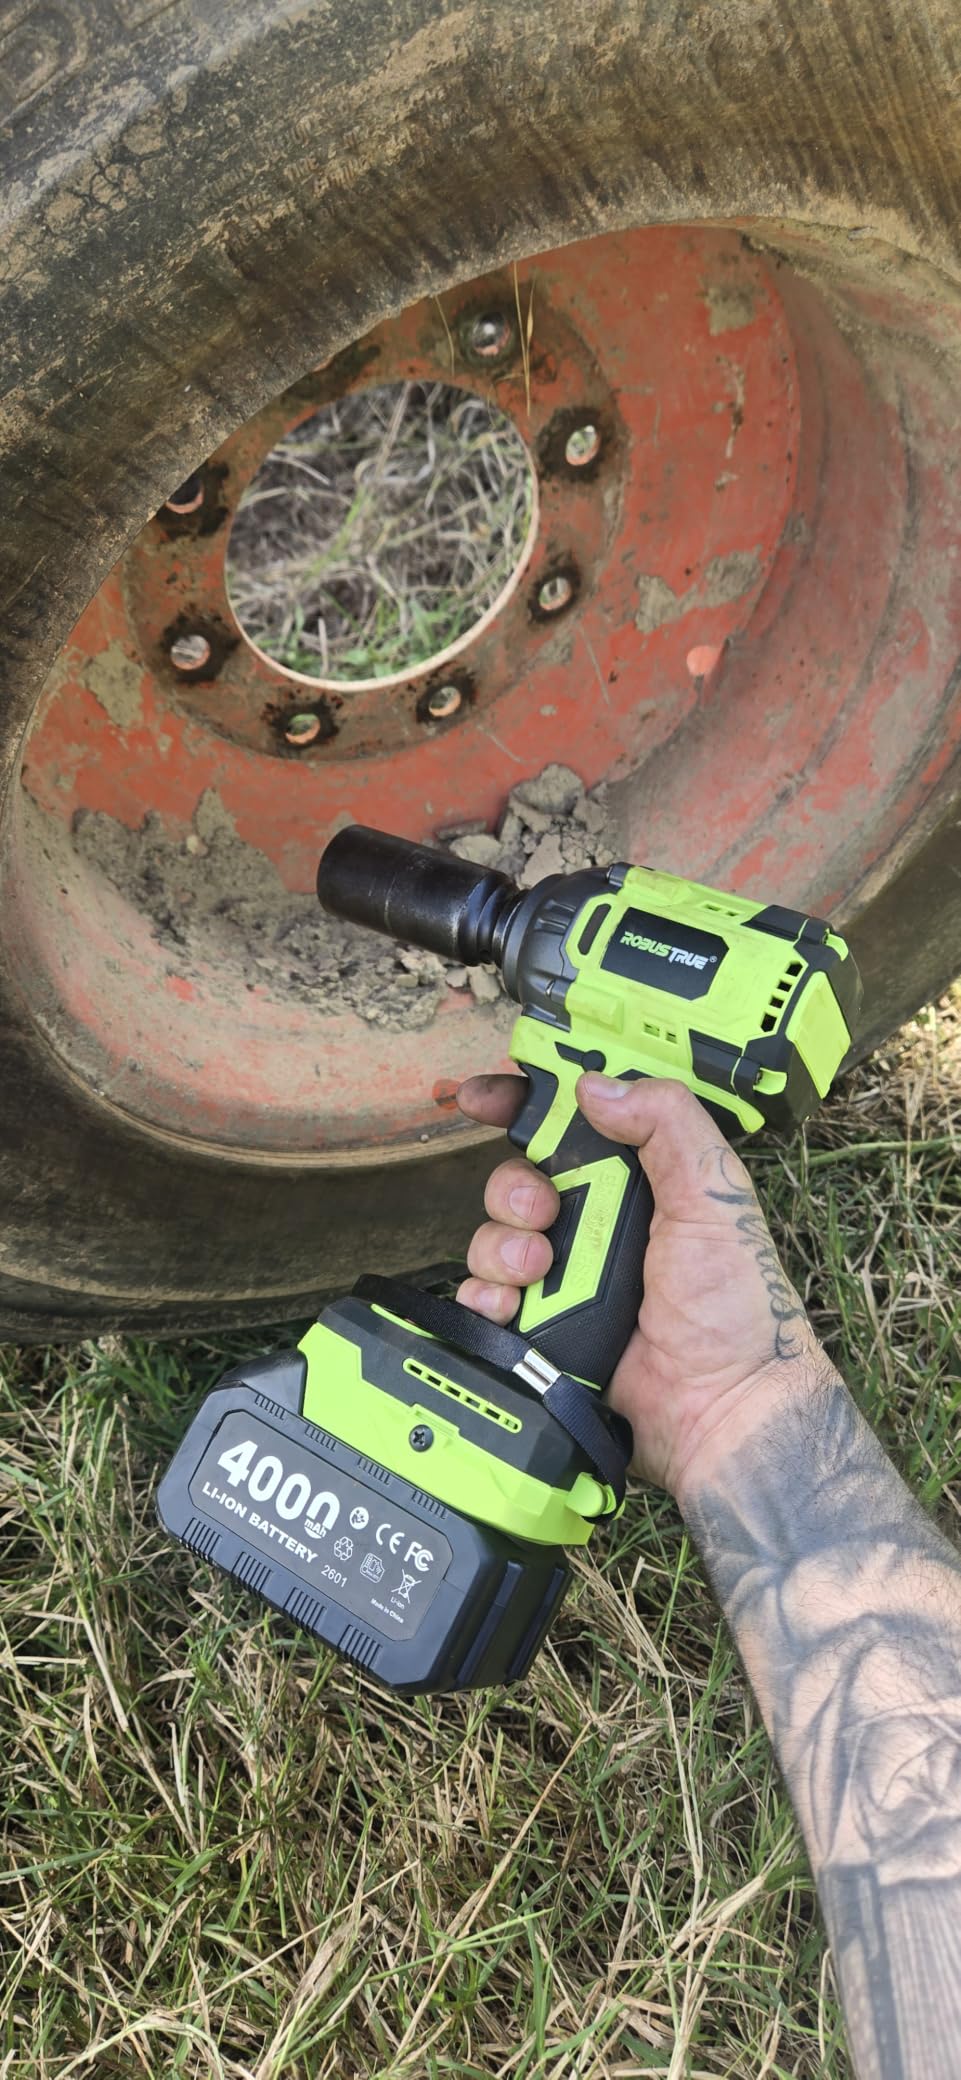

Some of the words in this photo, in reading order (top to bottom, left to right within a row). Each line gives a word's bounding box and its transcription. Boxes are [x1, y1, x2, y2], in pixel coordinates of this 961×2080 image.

[217, 1440, 340, 1539] 4000
[202, 1481, 247, 1518] LI-ION
[248, 1512, 318, 1564] BATTERY
[304, 1518, 327, 1538] mAh
[321, 1564, 348, 1588] 2601
